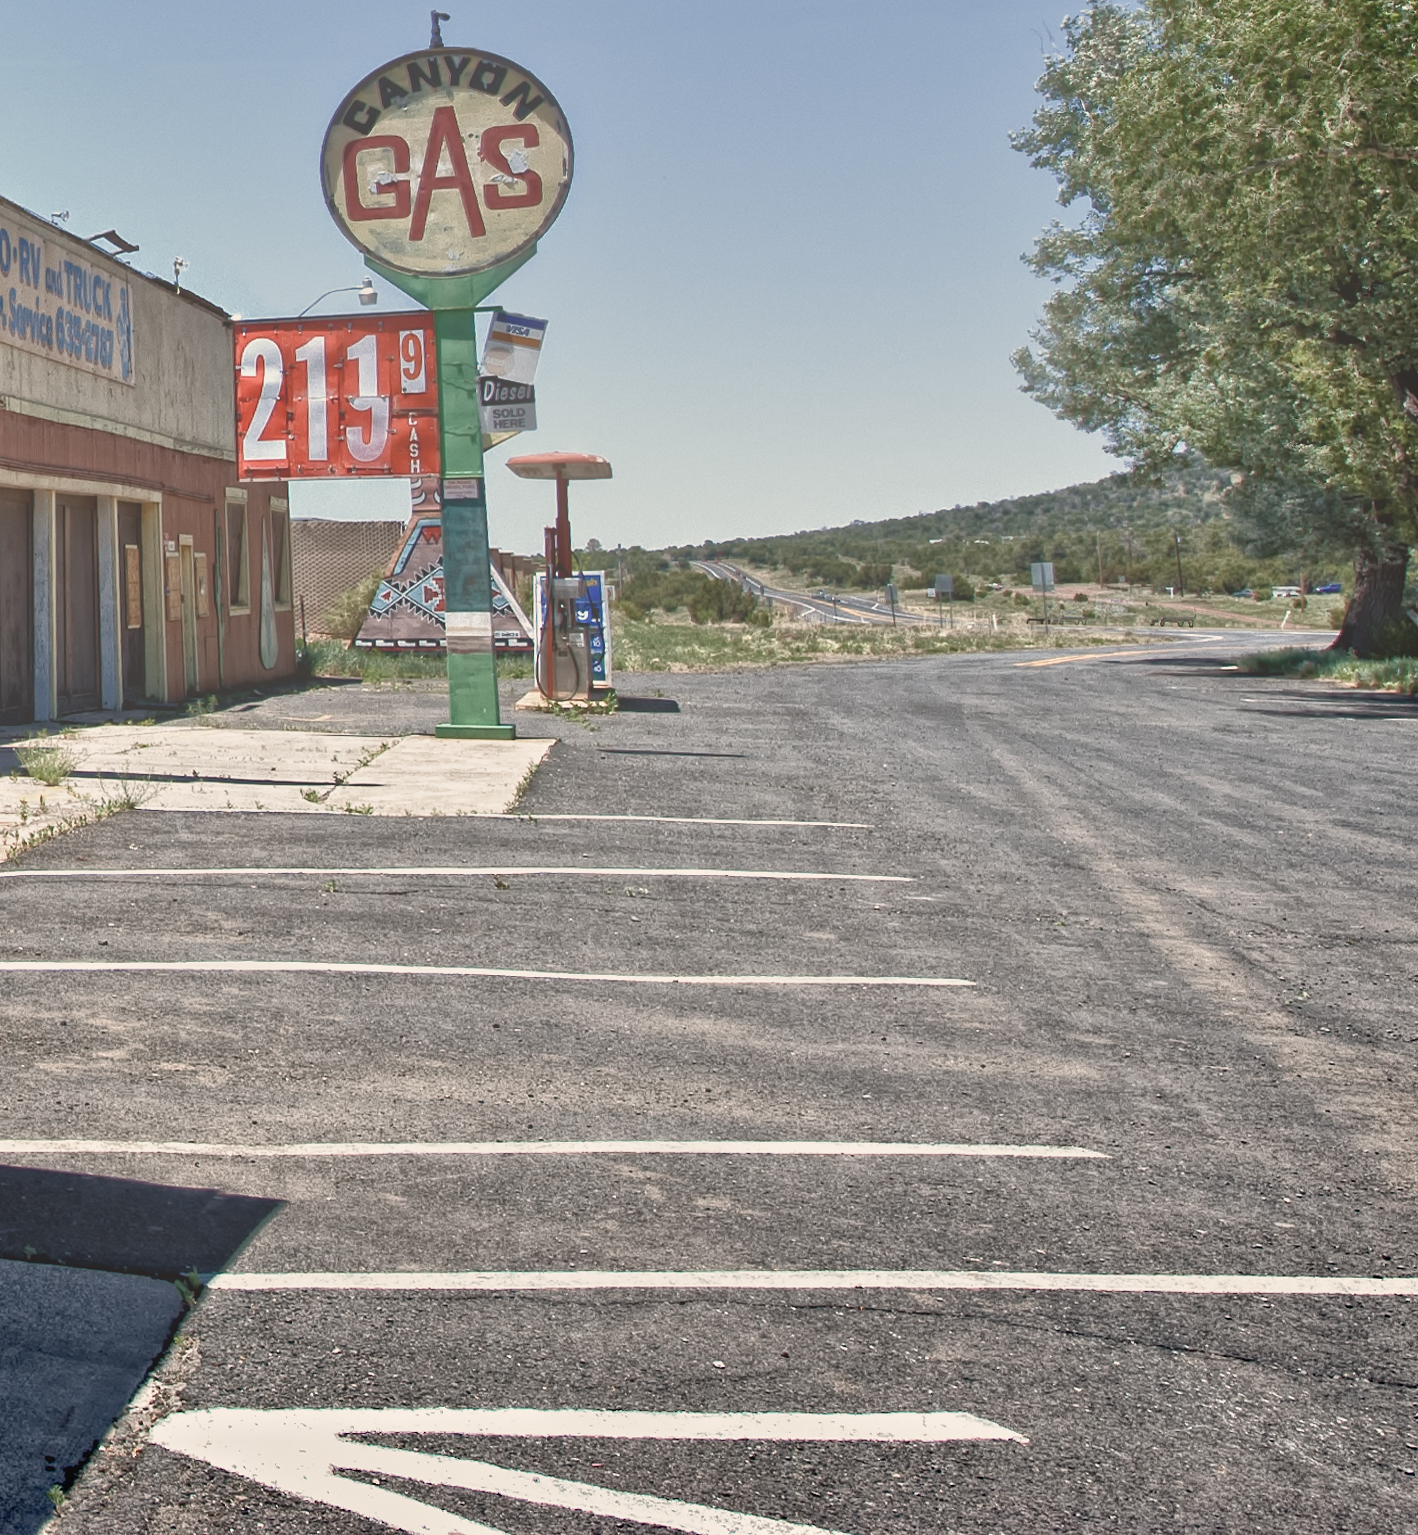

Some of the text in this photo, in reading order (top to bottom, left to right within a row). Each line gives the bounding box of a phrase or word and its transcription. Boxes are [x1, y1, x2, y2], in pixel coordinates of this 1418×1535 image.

[342, 54, 545, 135] CANYON
[341, 105, 544, 242] GAS
[45, 259, 64, 301] and
[64, 259, 114, 323] TRUCK
[8, 287, 54, 352] Service
[506, 324, 531, 337] VISA
[483, 380, 534, 403] Diesel
[492, 407, 527, 419] SOLD
[493, 418, 527, 430] HERE
